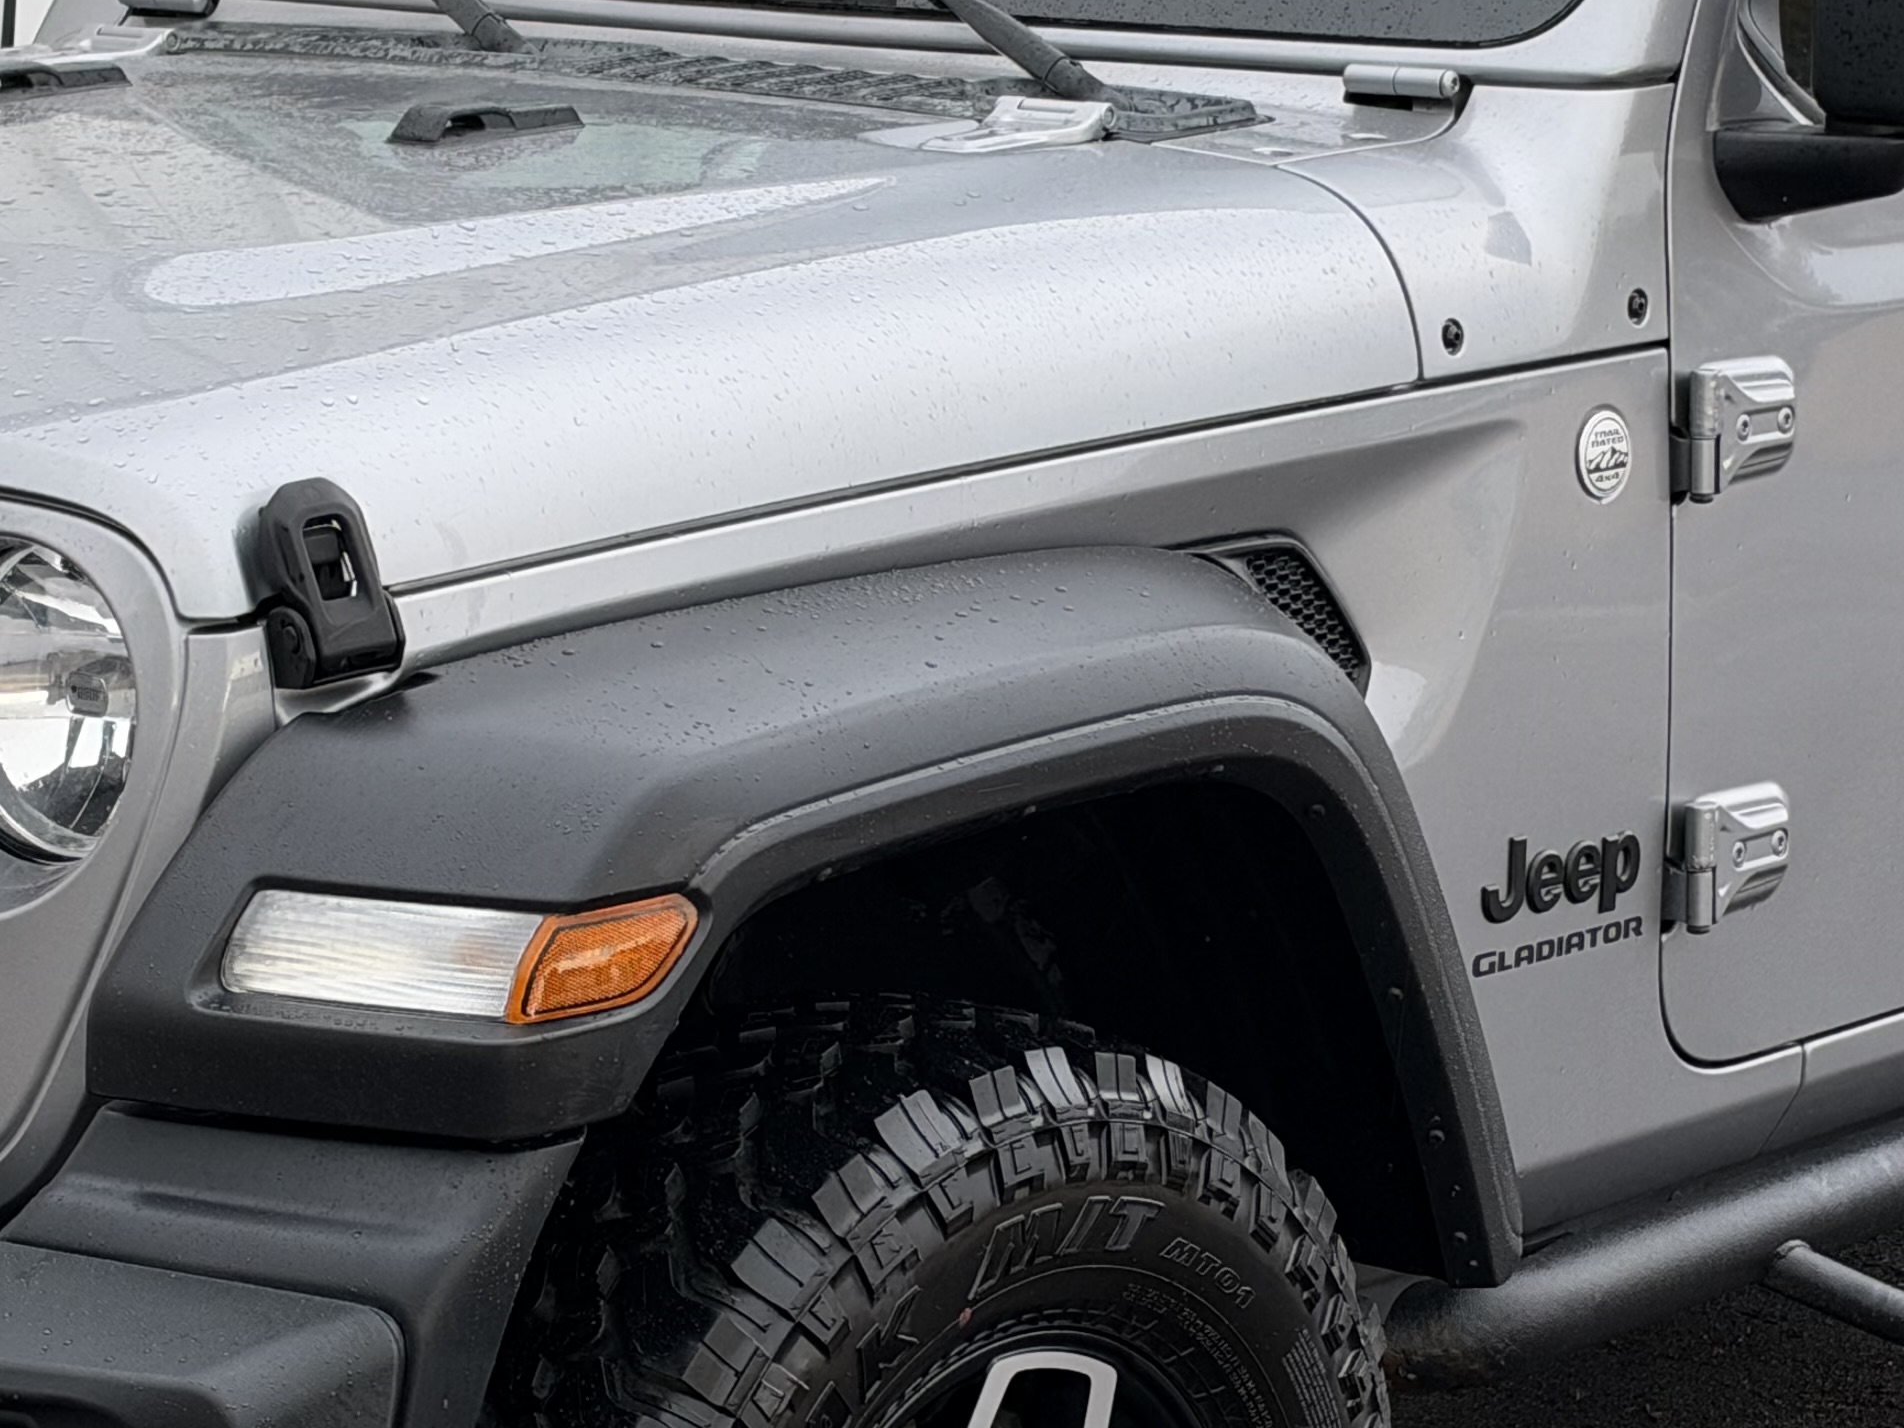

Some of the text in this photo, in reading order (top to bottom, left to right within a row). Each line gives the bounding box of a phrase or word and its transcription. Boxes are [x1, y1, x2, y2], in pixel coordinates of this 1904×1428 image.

[1592, 436, 1624, 448] RATED
[1595, 429, 1621, 439] TRAIL
[1481, 830, 1640, 924] Jeep
[1472, 915, 1643, 978] GLADIATOR
[1160, 1236, 1256, 1310] MT01
